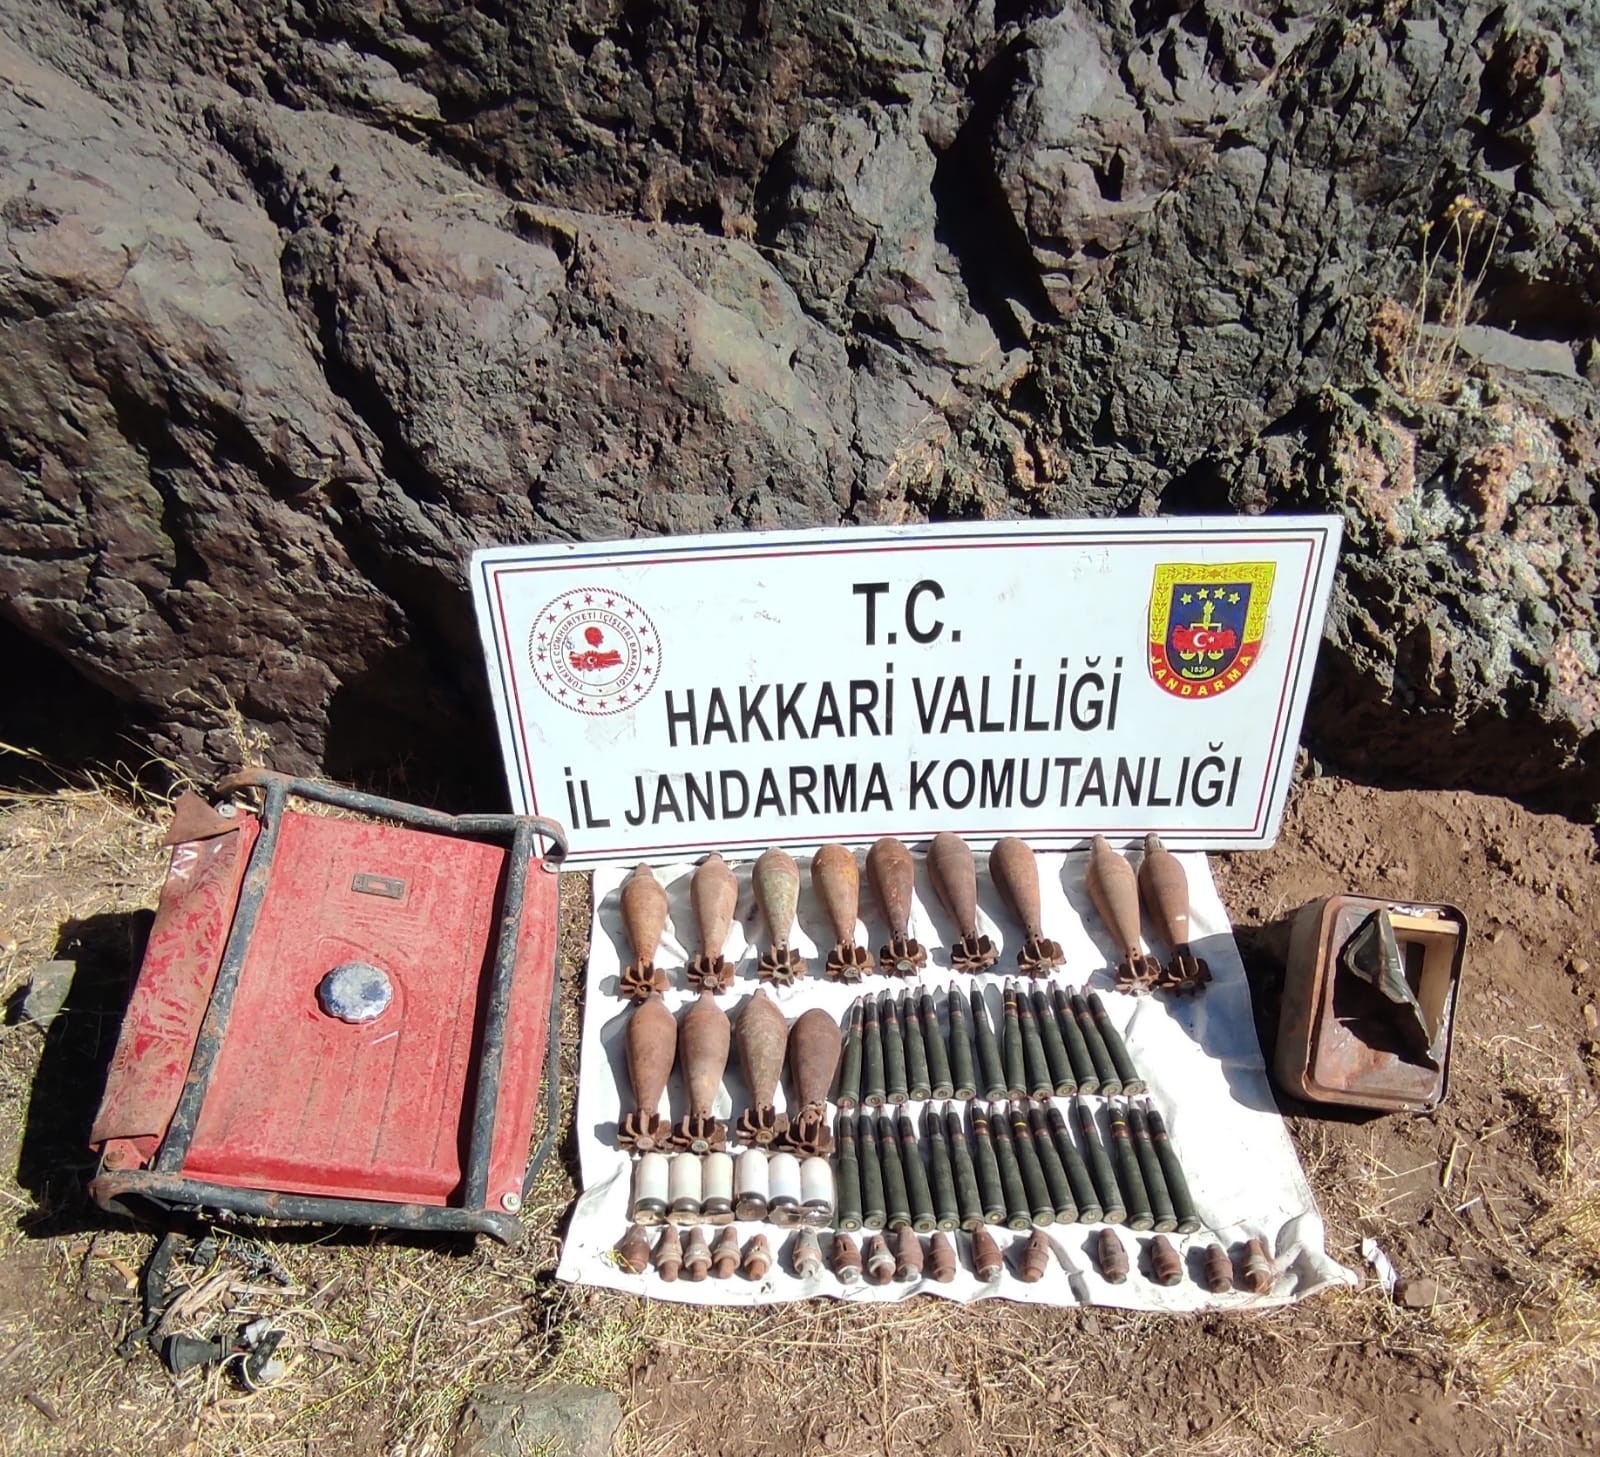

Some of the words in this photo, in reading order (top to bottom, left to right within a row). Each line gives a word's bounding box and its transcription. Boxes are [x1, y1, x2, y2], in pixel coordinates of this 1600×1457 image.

[853, 580, 961, 645] T.C.
[666, 662, 893, 746] HAKKARİ
[911, 655, 1122, 735] VALİLİĞİ
[1150, 655, 1253, 696] JANDARMA
[564, 766, 610, 829] İL
[625, 762, 892, 825] JANDARMA
[910, 741, 1241, 813] KOMUTANLIĞI
